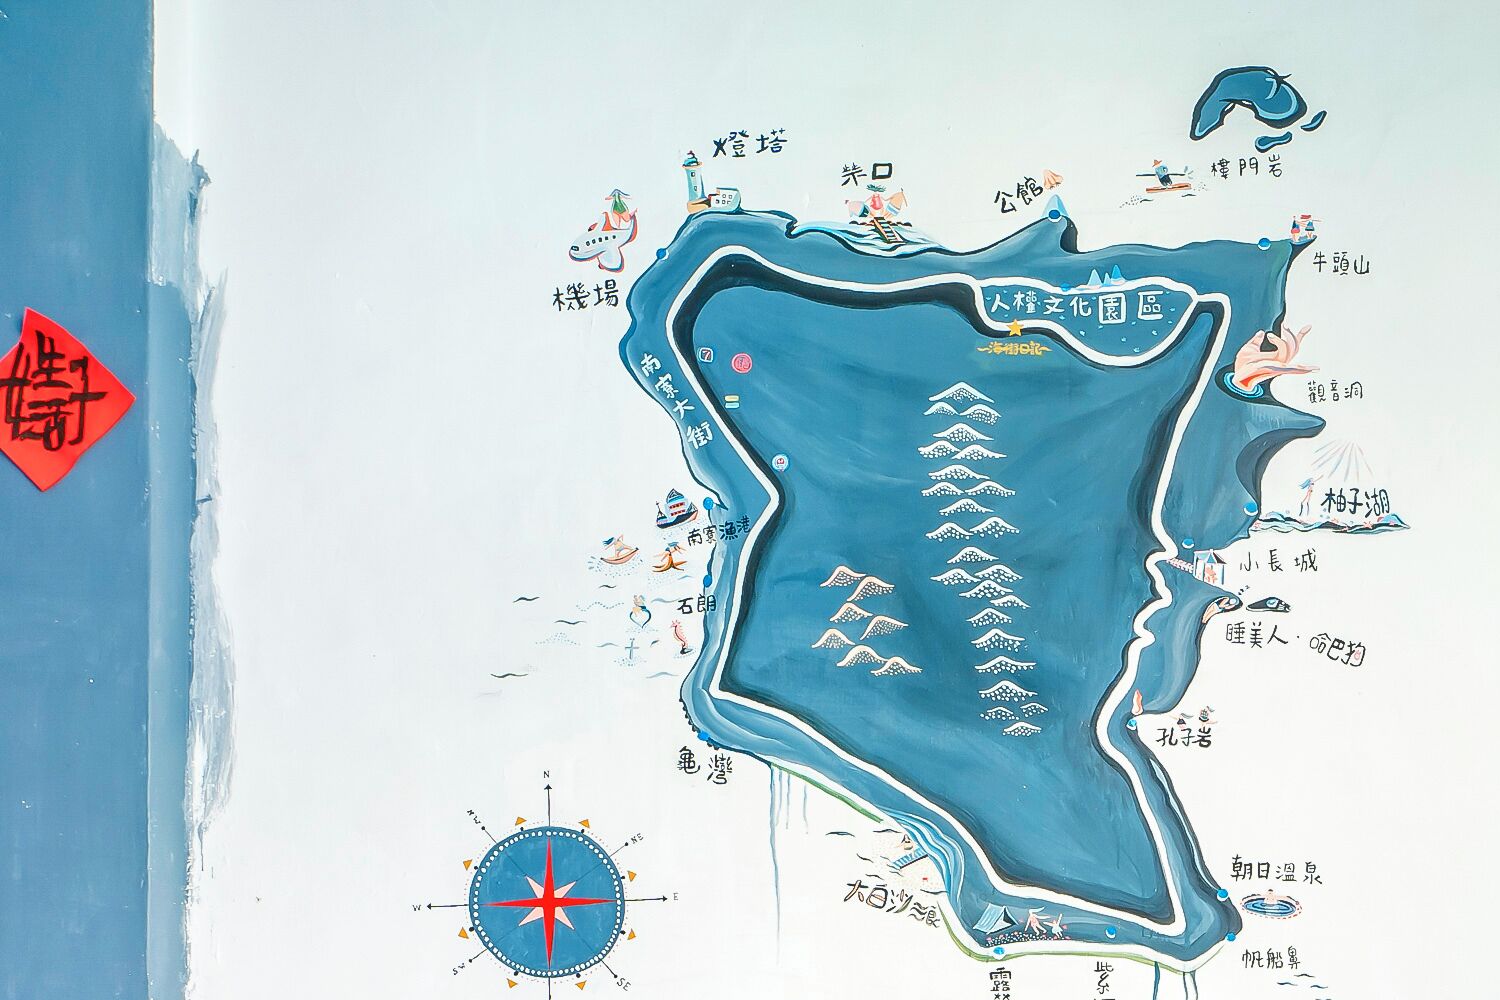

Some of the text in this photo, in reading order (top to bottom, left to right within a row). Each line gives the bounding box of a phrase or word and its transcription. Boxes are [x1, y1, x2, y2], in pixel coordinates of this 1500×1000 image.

[713, 129, 787, 158] 燈塔
[1210, 154, 1283, 180] 樓門岩
[994, 176, 1043, 214] 公館
[1312, 252, 1370, 276] 牛頭山
[552, 280, 619, 312] 機場
[990, 290, 1164, 324] 人權文化園區
[1307, 379, 1363, 403] 觀音洞
[1321, 487, 1390, 518] 柚子湖
[687, 515, 751, 547] 南寮漁港
[1240, 548, 1318, 572] 小長城
[676, 594, 717, 615] 石朗
[1156, 727, 1212, 748] 孔子岩
[543, 770, 550, 779] N
[676, 746, 733, 785] 龜灣
[631, 833, 644, 845] NE
[1231, 854, 1323, 885] 朝日溫泉
[412, 904, 422, 912] W
[673, 893, 679, 901] E
[1242, 946, 1301, 970] 帆船鼻
[616, 977, 632, 992] SE
